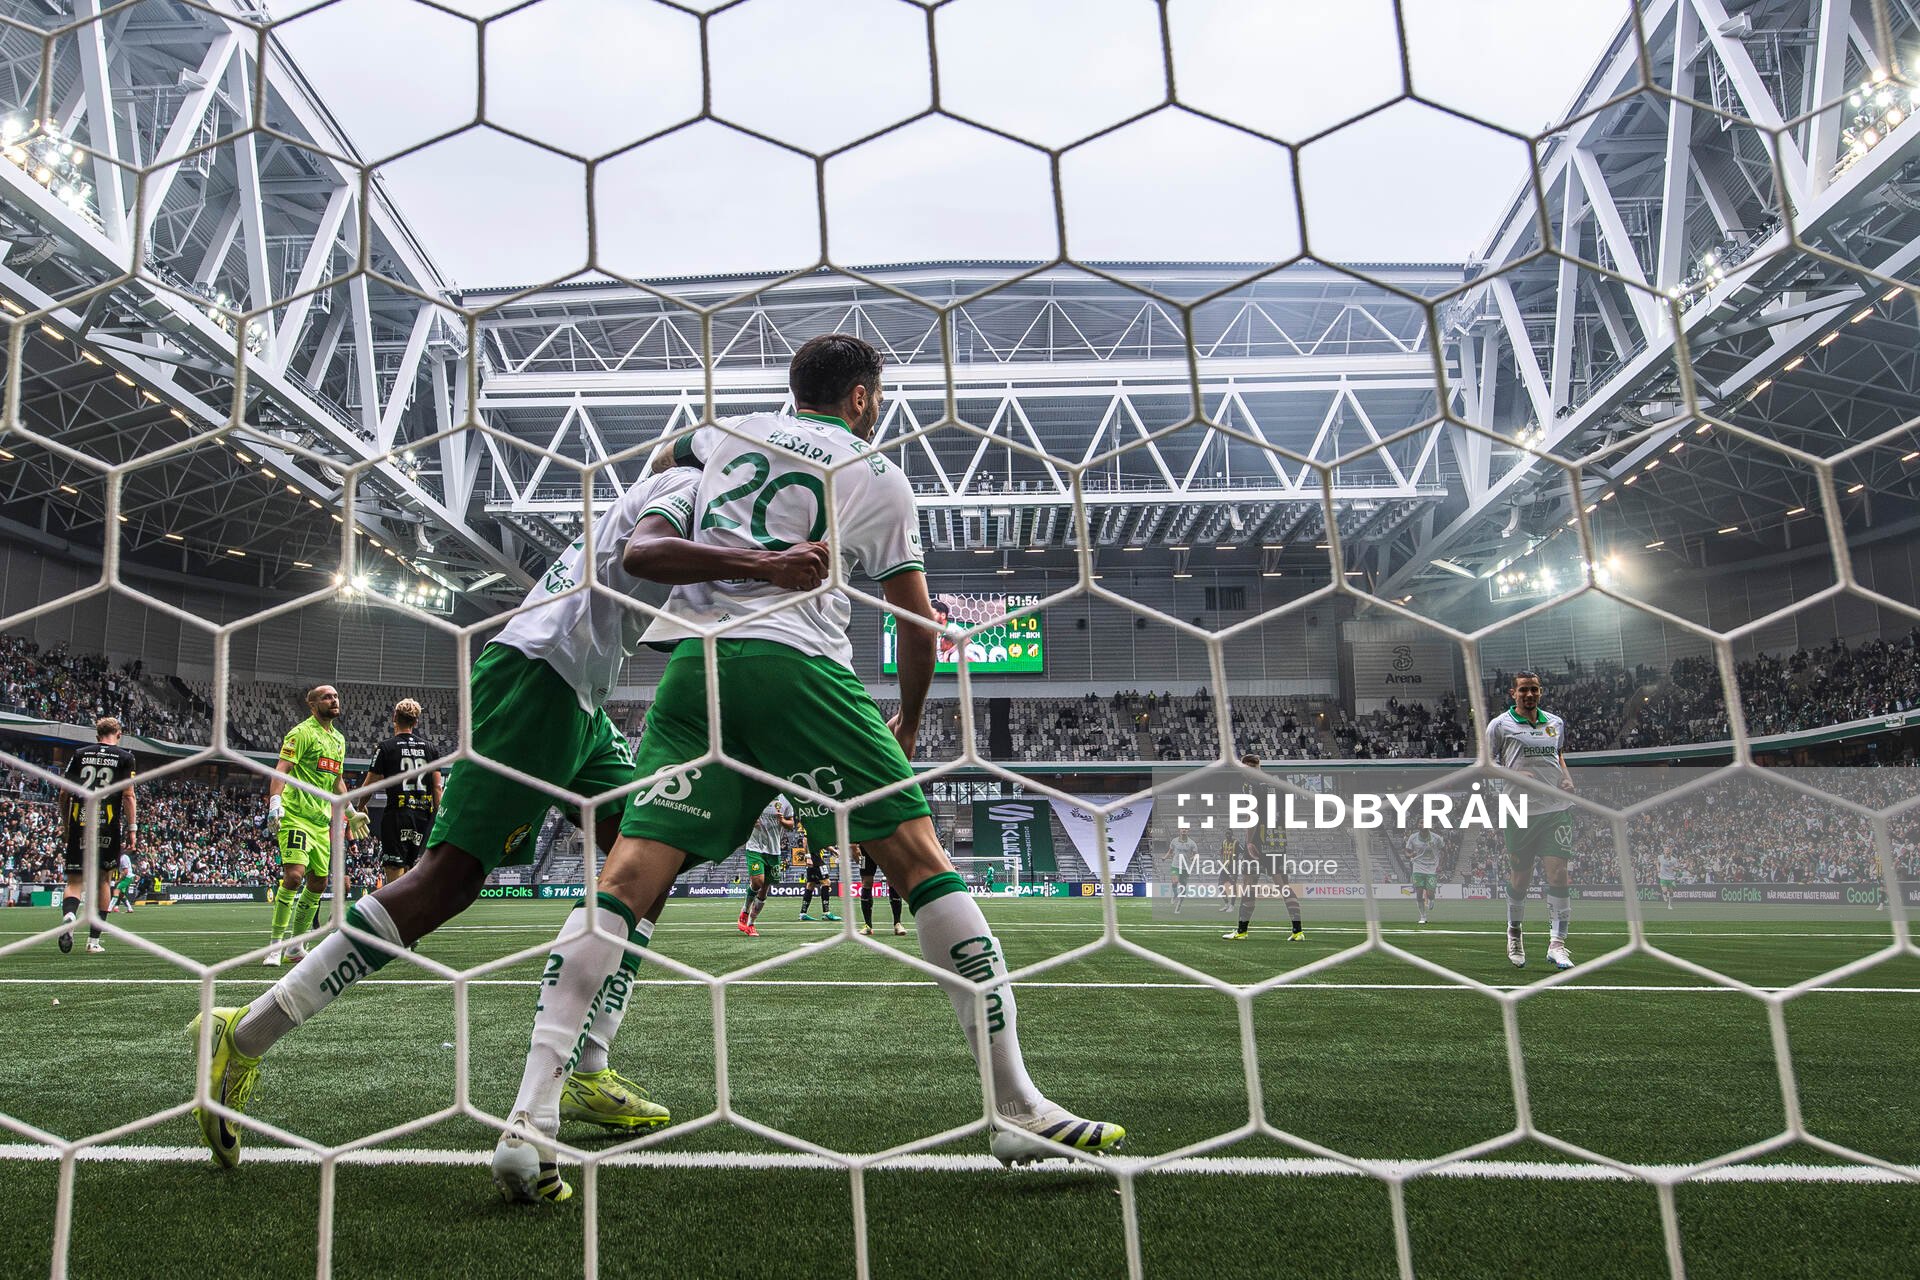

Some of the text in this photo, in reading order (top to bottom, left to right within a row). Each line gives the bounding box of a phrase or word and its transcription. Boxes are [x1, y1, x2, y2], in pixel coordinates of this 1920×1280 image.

[701, 452, 829, 550] 20
[1007, 595, 1038, 606] 51:56
[1385, 673, 1422, 684] Arena
[80, 765, 113, 792] 23
[400, 757, 428, 792] 22
[653, 798, 712, 820] MARKSERVICE AB
[480, 886, 533, 897] ood Folks
[689, 886, 747, 895] AudicomPendax
[1315, 887, 1378, 895] INTERSPOT
[1462, 887, 1492, 899] DICKENS
[1721, 887, 1762, 902] Good Folks
[1846, 886, 1874, 904] Good
